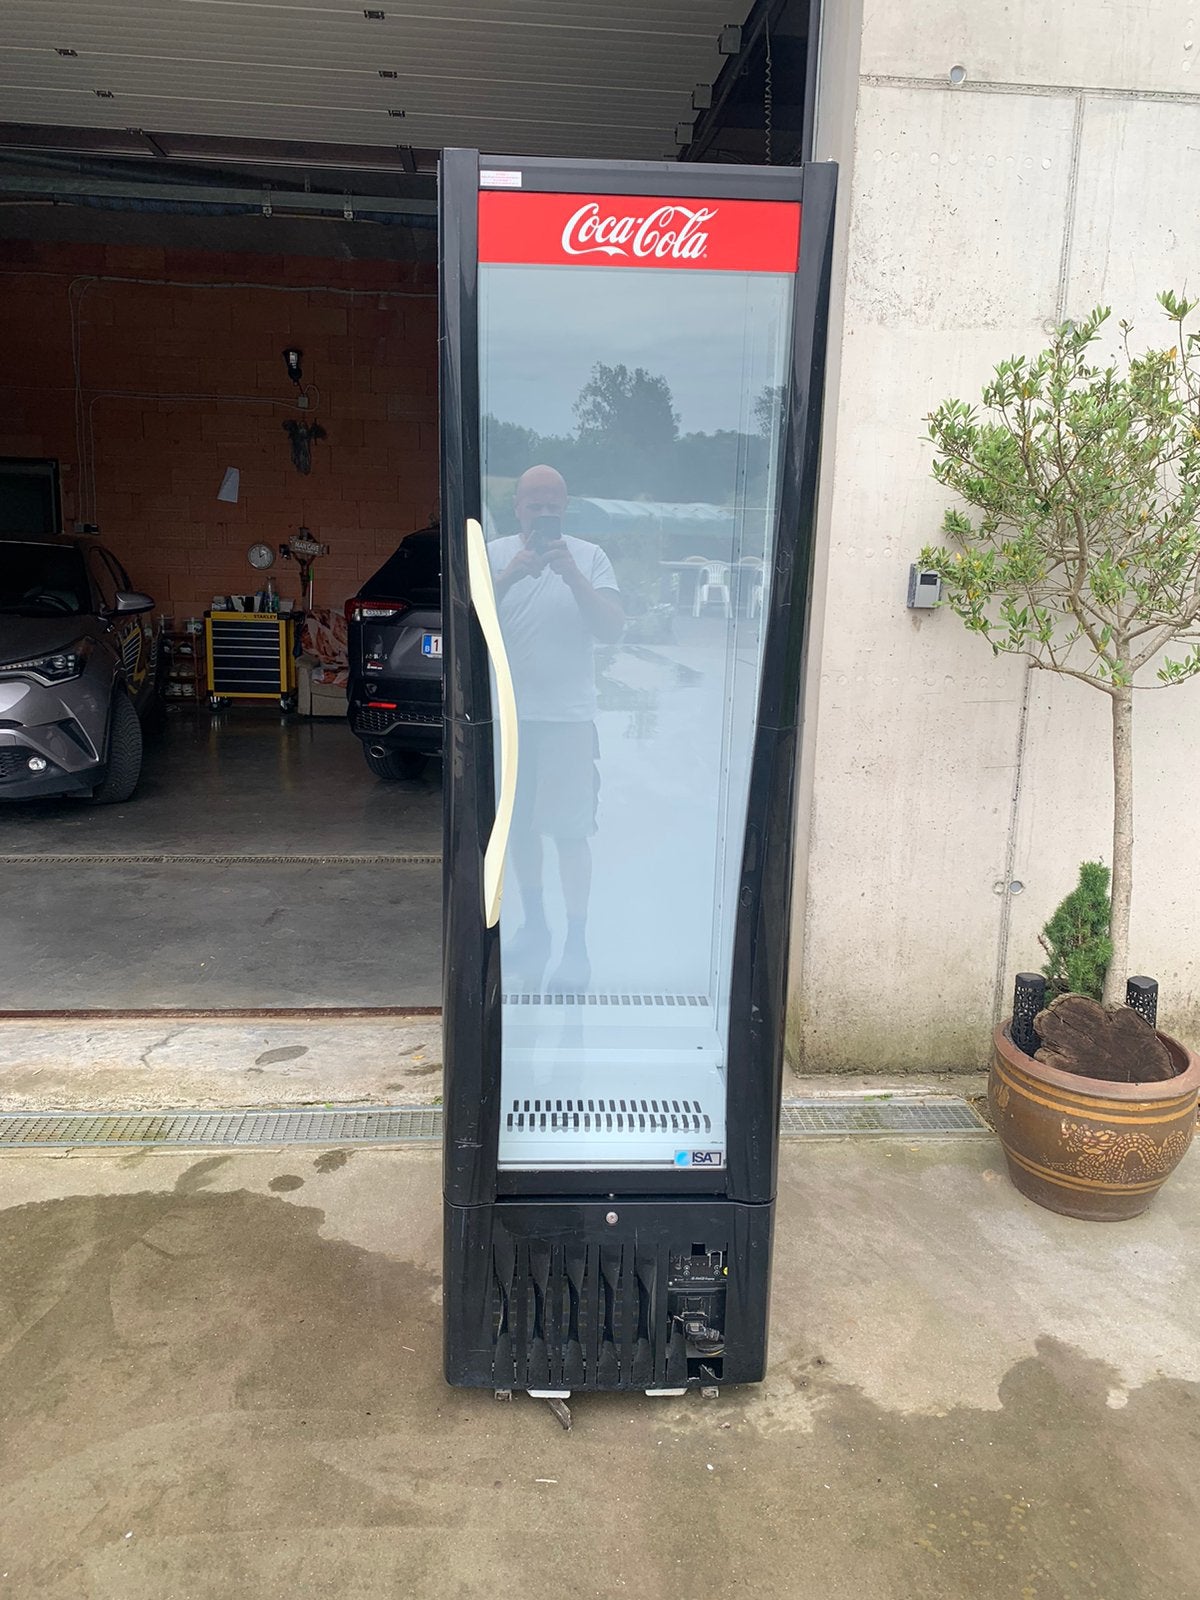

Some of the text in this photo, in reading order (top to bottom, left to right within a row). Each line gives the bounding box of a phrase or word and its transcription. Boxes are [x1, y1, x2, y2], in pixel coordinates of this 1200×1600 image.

[561, 202, 719, 259] Coca-Cola
[295, 542, 307, 550] MAN
[692, 1151, 712, 1163] ISA
